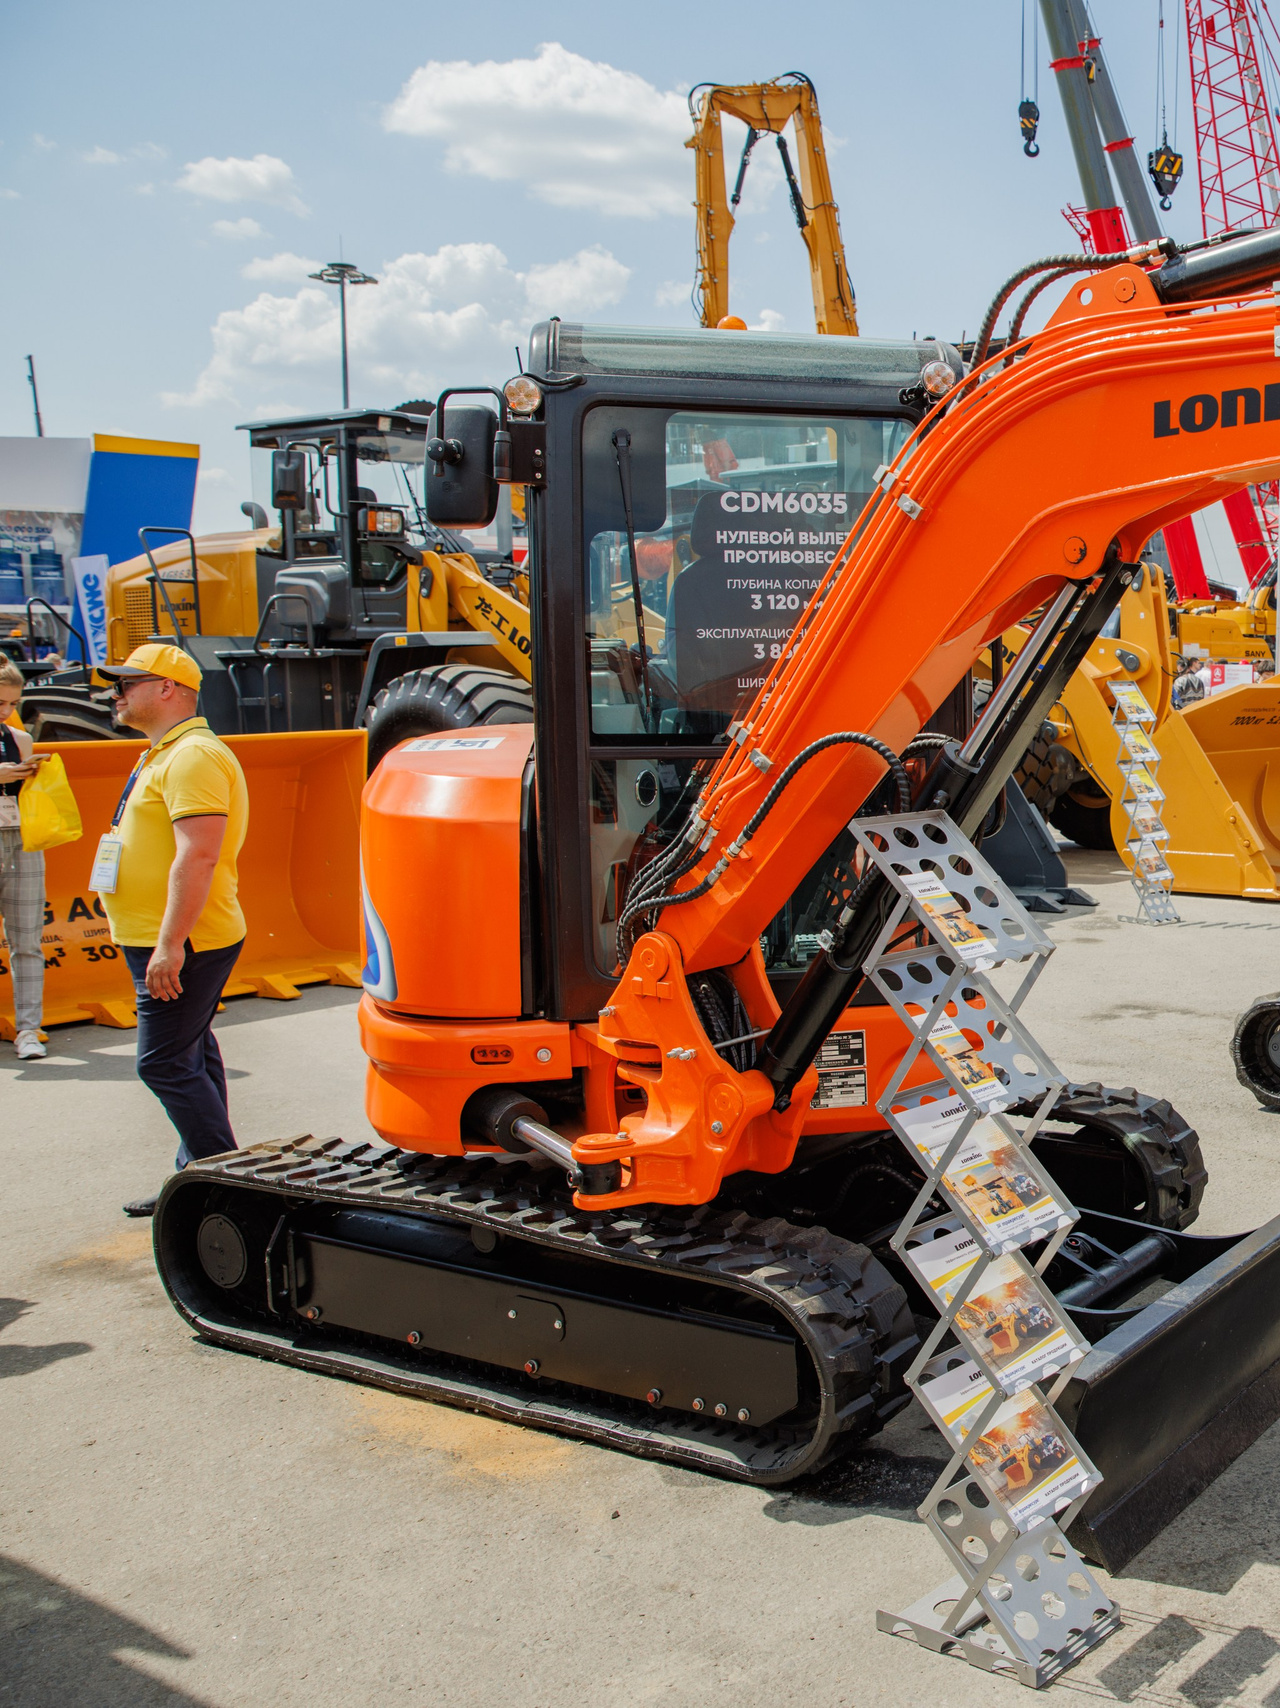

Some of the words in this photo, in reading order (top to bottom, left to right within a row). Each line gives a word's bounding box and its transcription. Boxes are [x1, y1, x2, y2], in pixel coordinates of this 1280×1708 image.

[719, 491, 848, 514] CDM6035
[716, 528, 795, 545] НУЛЕВОЙ
[727, 579, 782, 590] ГЛУБИНА
[751, 594, 763, 610] 3
[767, 594, 800, 610] 120
[753, 643, 766, 659] 3
